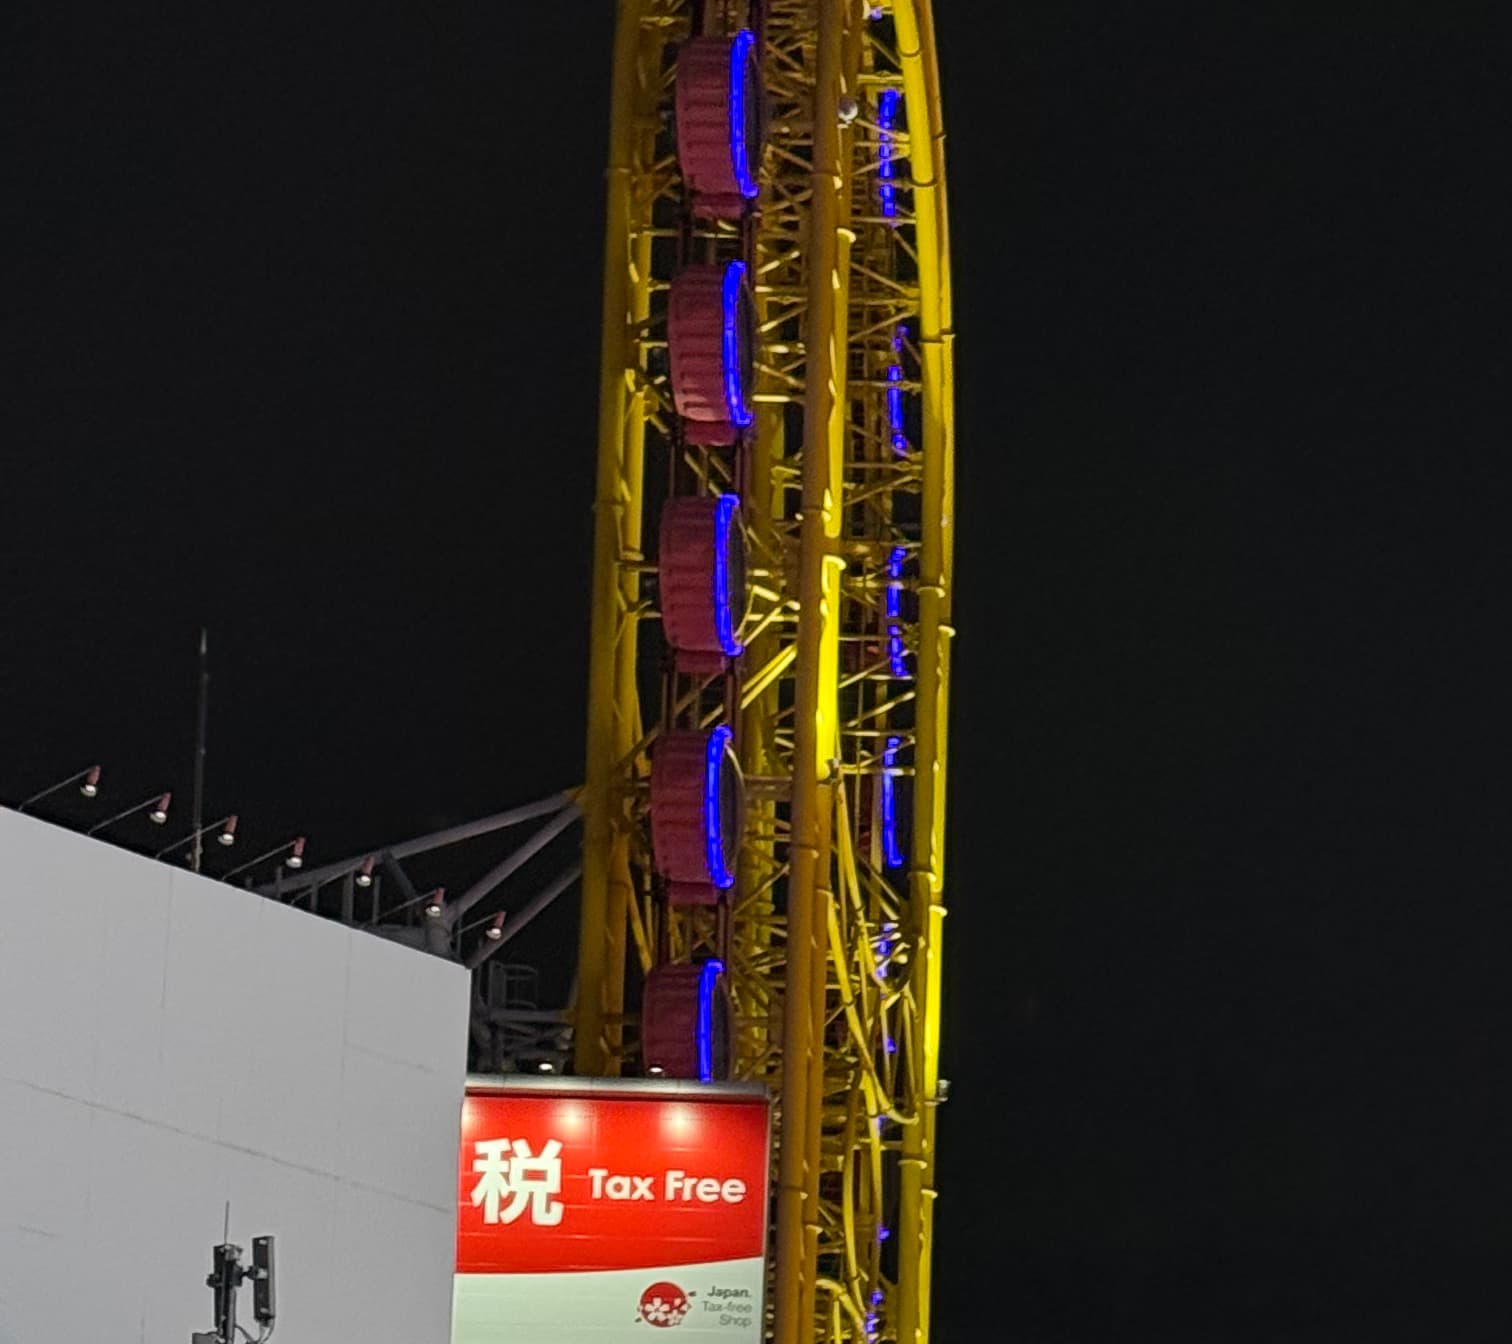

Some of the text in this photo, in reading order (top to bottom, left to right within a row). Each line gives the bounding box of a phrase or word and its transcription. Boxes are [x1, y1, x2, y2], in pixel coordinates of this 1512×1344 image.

[470, 1137, 565, 1226] 税
[588, 1168, 747, 1203] Tax Free
[719, 1314, 752, 1327] Shop
